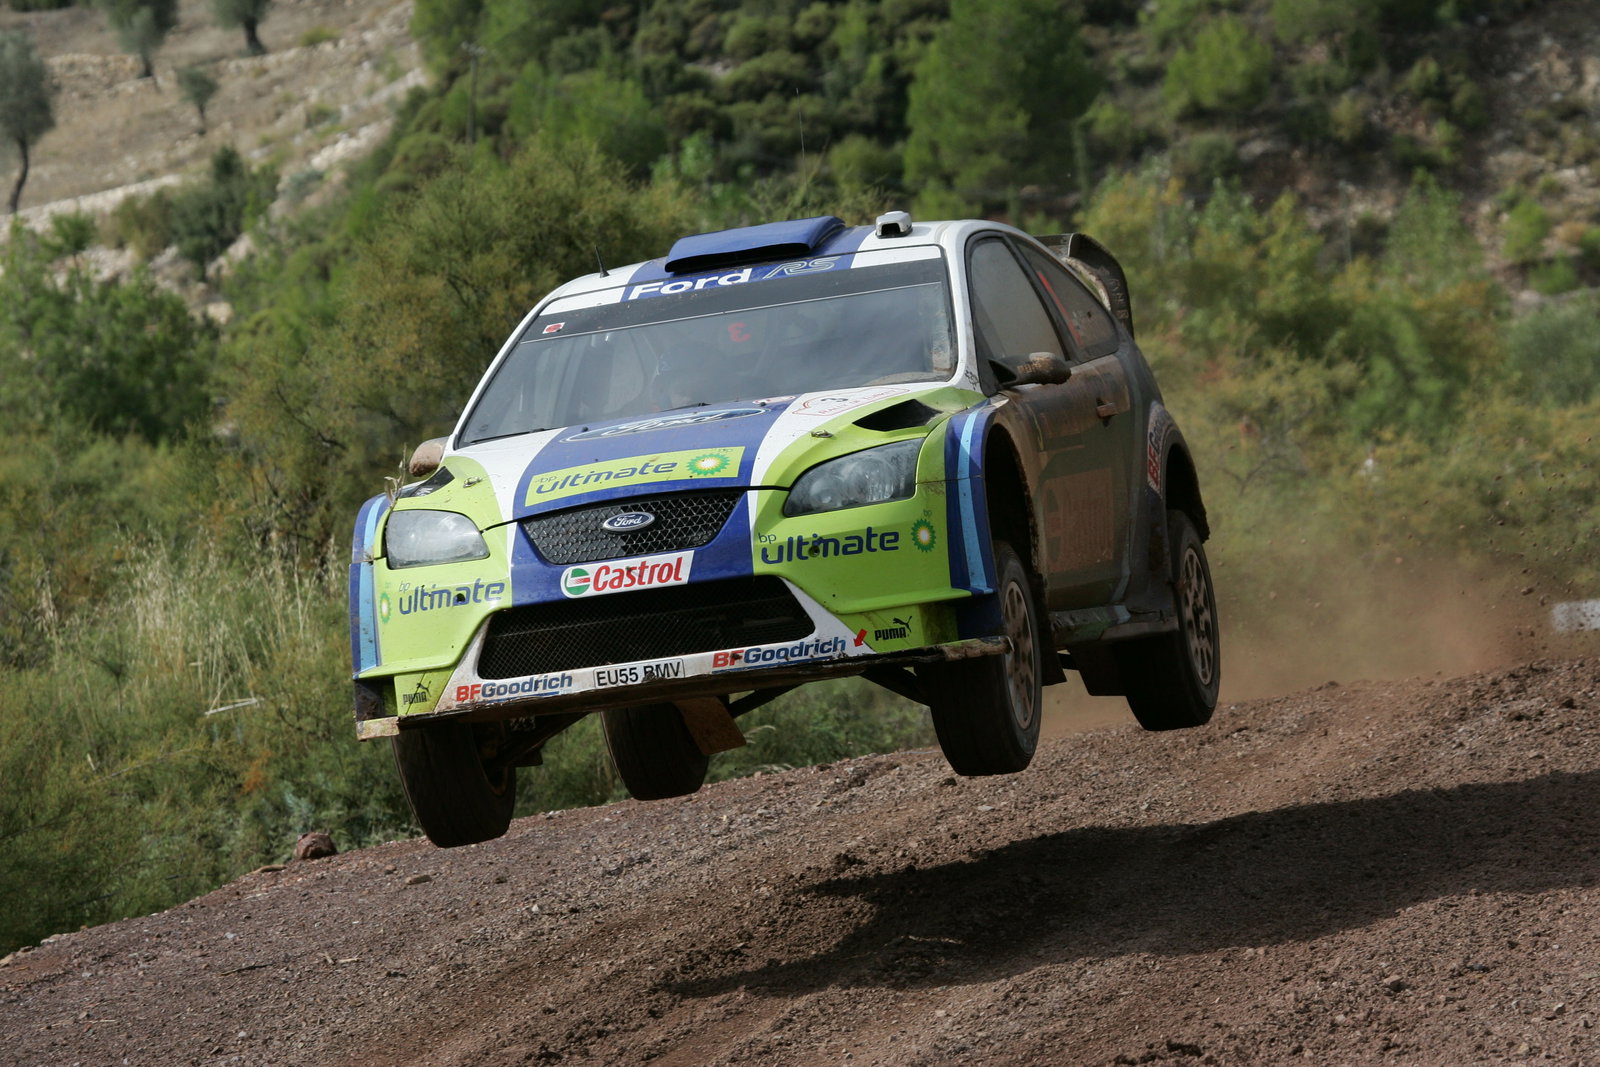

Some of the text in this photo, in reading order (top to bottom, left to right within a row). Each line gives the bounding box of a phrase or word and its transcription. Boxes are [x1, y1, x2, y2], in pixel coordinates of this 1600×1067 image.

[628, 255, 842, 300] Ford RS
[536, 462, 678, 495] ultimate
[613, 514, 642, 527] Ford
[758, 532, 777, 545] bp
[761, 527, 900, 565] ultimate
[593, 557, 683, 592] Castrol
[399, 578, 505, 615] ultimate
[874, 627, 907, 641] PUMA
[712, 637, 846, 668] BFGoodrich
[456, 673, 573, 702] BFGoodrich
[596, 661, 680, 687] EU55 BMV
